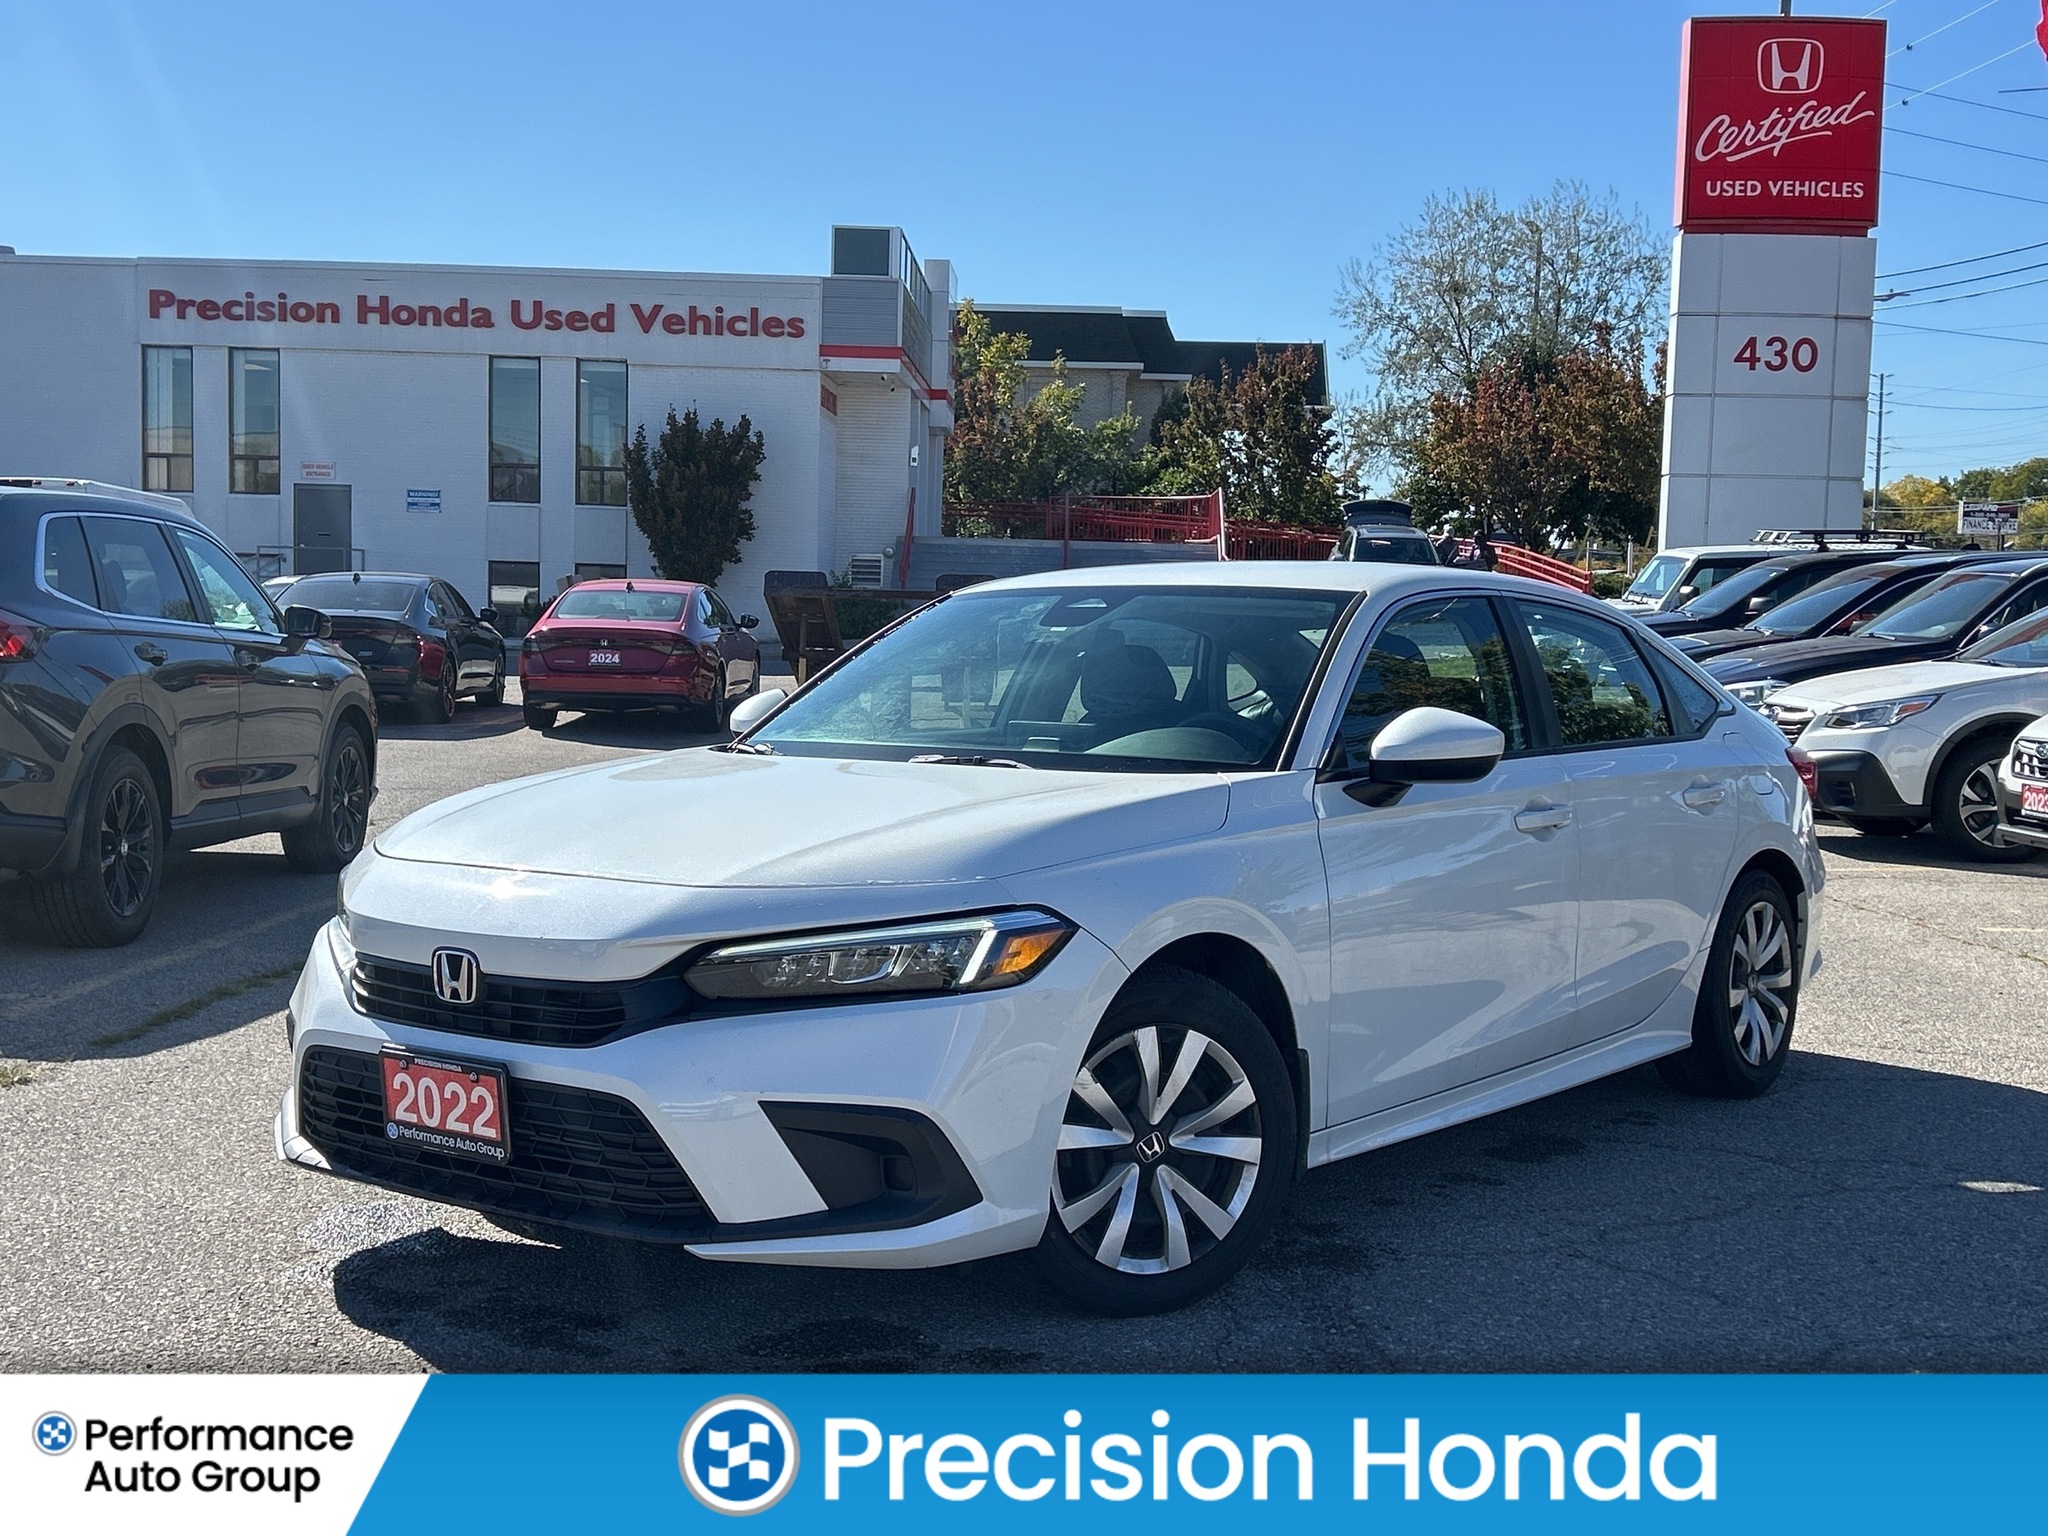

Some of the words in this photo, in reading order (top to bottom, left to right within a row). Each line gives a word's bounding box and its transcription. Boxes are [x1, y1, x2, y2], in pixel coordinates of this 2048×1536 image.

[1695, 91, 1875, 162] Certified
[1706, 181, 1761, 196] USED
[1768, 181, 1864, 198] VEHICLES
[149, 289, 340, 323] Precision
[357, 294, 495, 328] Honda
[510, 299, 615, 333] Used
[630, 303, 806, 339] Vehicles
[1734, 335, 1819, 373] 430
[590, 653, 620, 663] 2024
[414, 1057, 442, 1069] PRECISION
[442, 1062, 463, 1073] HONDA
[393, 1072, 497, 1139] 2022
[399, 1125, 456, 1148] Performance
[456, 1137, 476, 1152] Auto
[476, 1142, 505, 1160] Group
